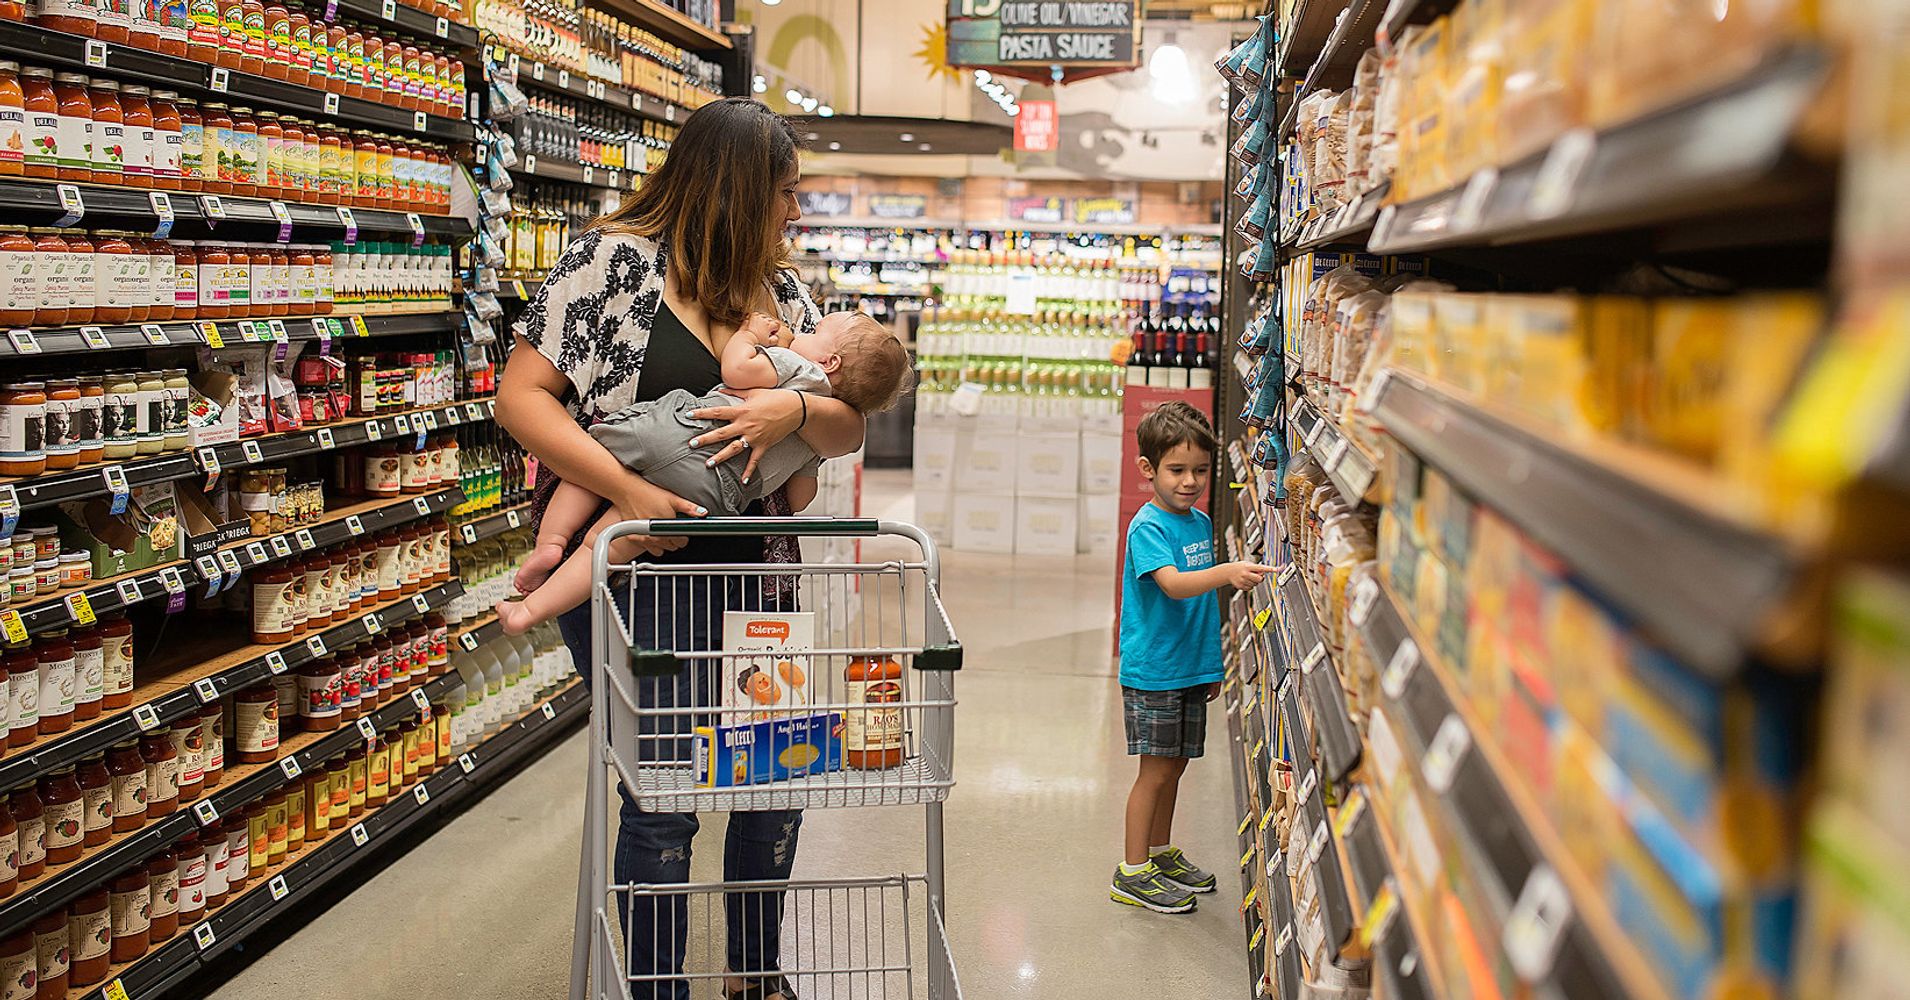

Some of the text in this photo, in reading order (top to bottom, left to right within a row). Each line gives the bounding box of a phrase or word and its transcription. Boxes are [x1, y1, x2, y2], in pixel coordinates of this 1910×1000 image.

[1001, 2, 1129, 26] OLIVE OIL/VINEGAR
[999, 34, 1115, 60] PASTA SAUCE
[1, 112, 24, 122] DELALL
[38, 119, 57, 127] DELALL
[1323, 258, 1339, 268] CECCO
[14, 276, 35, 284] organi
[47, 276, 69, 284] organi
[74, 276, 94, 284] organi
[1182, 542, 1199, 555] KEEP
[749, 625, 785, 635] Tolerant
